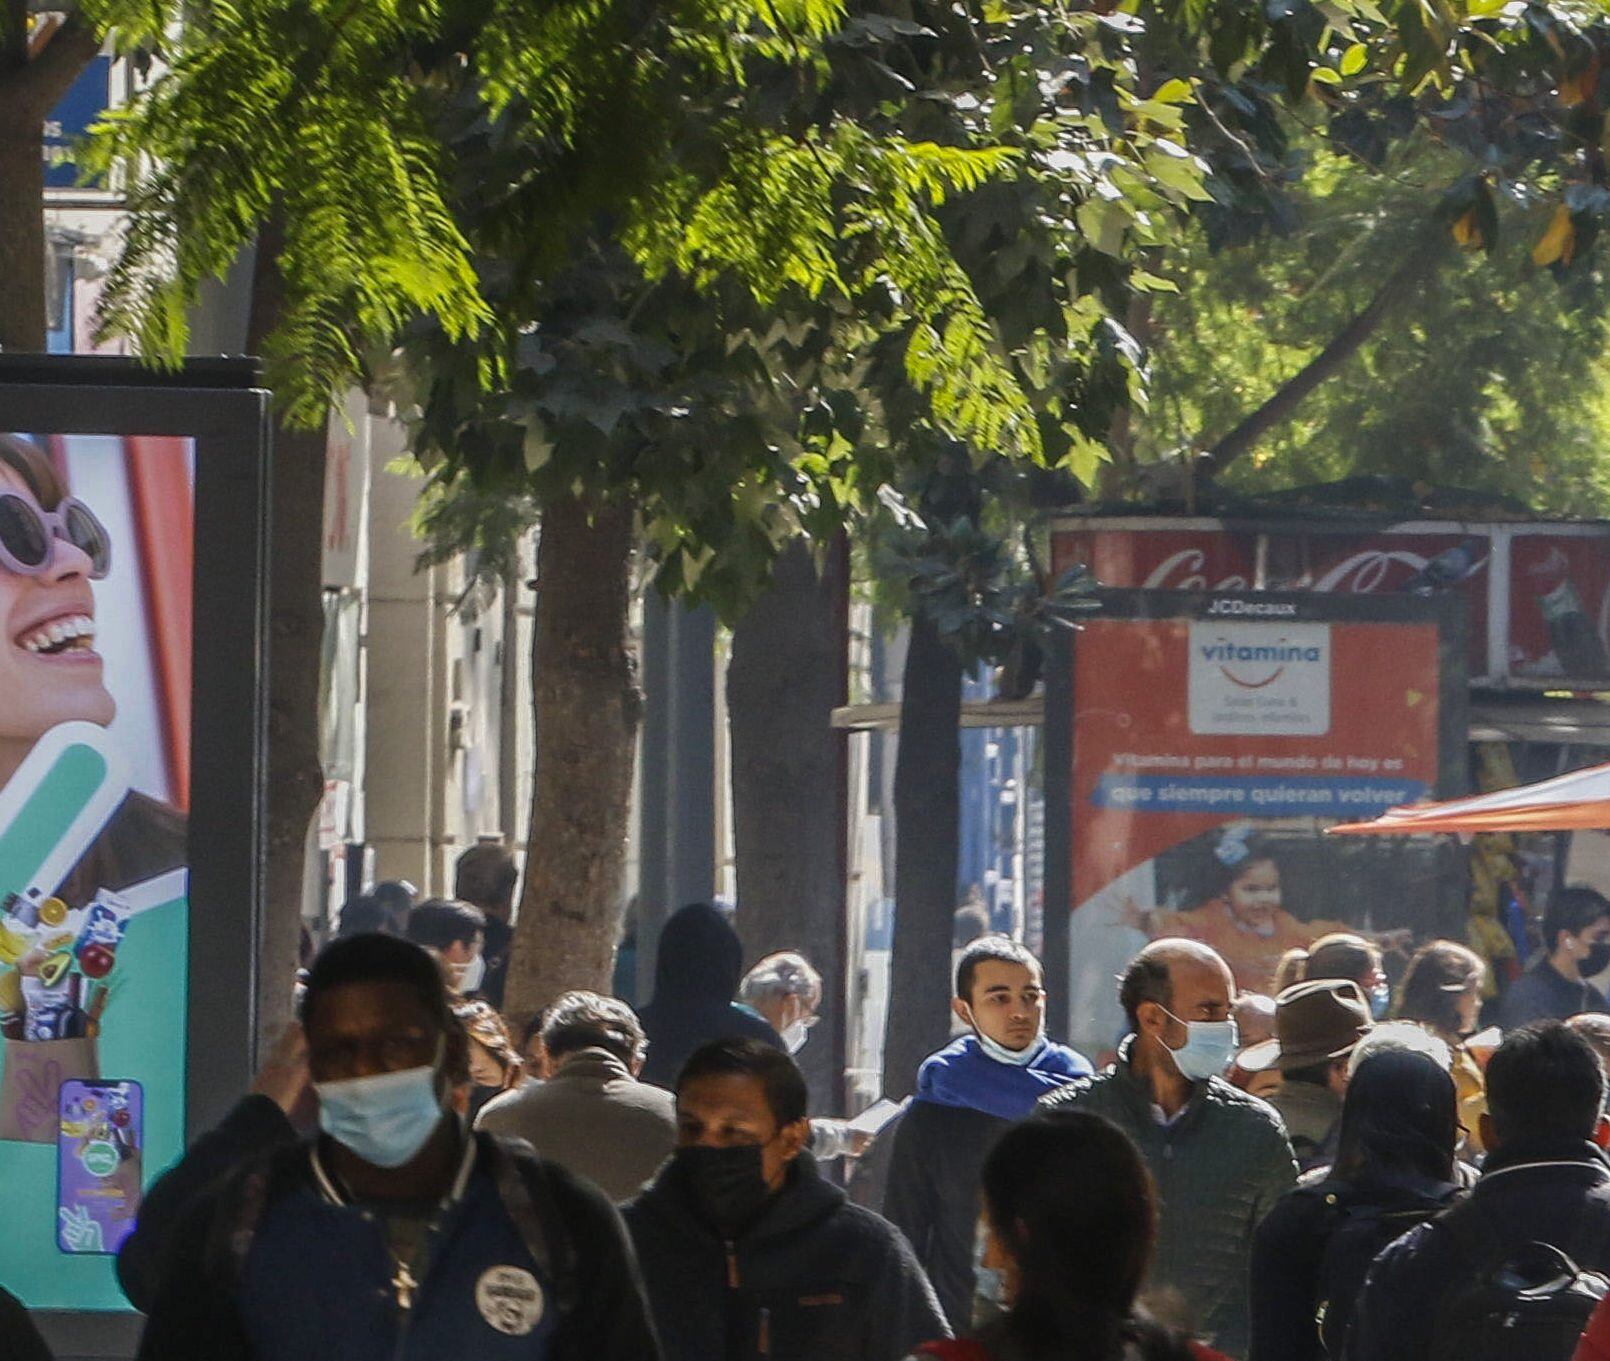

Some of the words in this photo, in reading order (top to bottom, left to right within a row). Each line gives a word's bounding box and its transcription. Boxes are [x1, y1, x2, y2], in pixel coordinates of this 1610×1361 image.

[1207, 599, 1297, 616] JCDecaux
[1201, 640, 1321, 662] vitamina
[1112, 753, 1190, 768] Vitamina
[1194, 756, 1235, 770] para
[1256, 755, 1317, 768] mundo
[1321, 755, 1343, 769] de
[1346, 755, 1377, 771] hoy
[1111, 787, 1152, 804] que
[1157, 783, 1245, 804] siempre
[1251, 784, 1333, 805] quieran
[1338, 786, 1406, 802] volver
